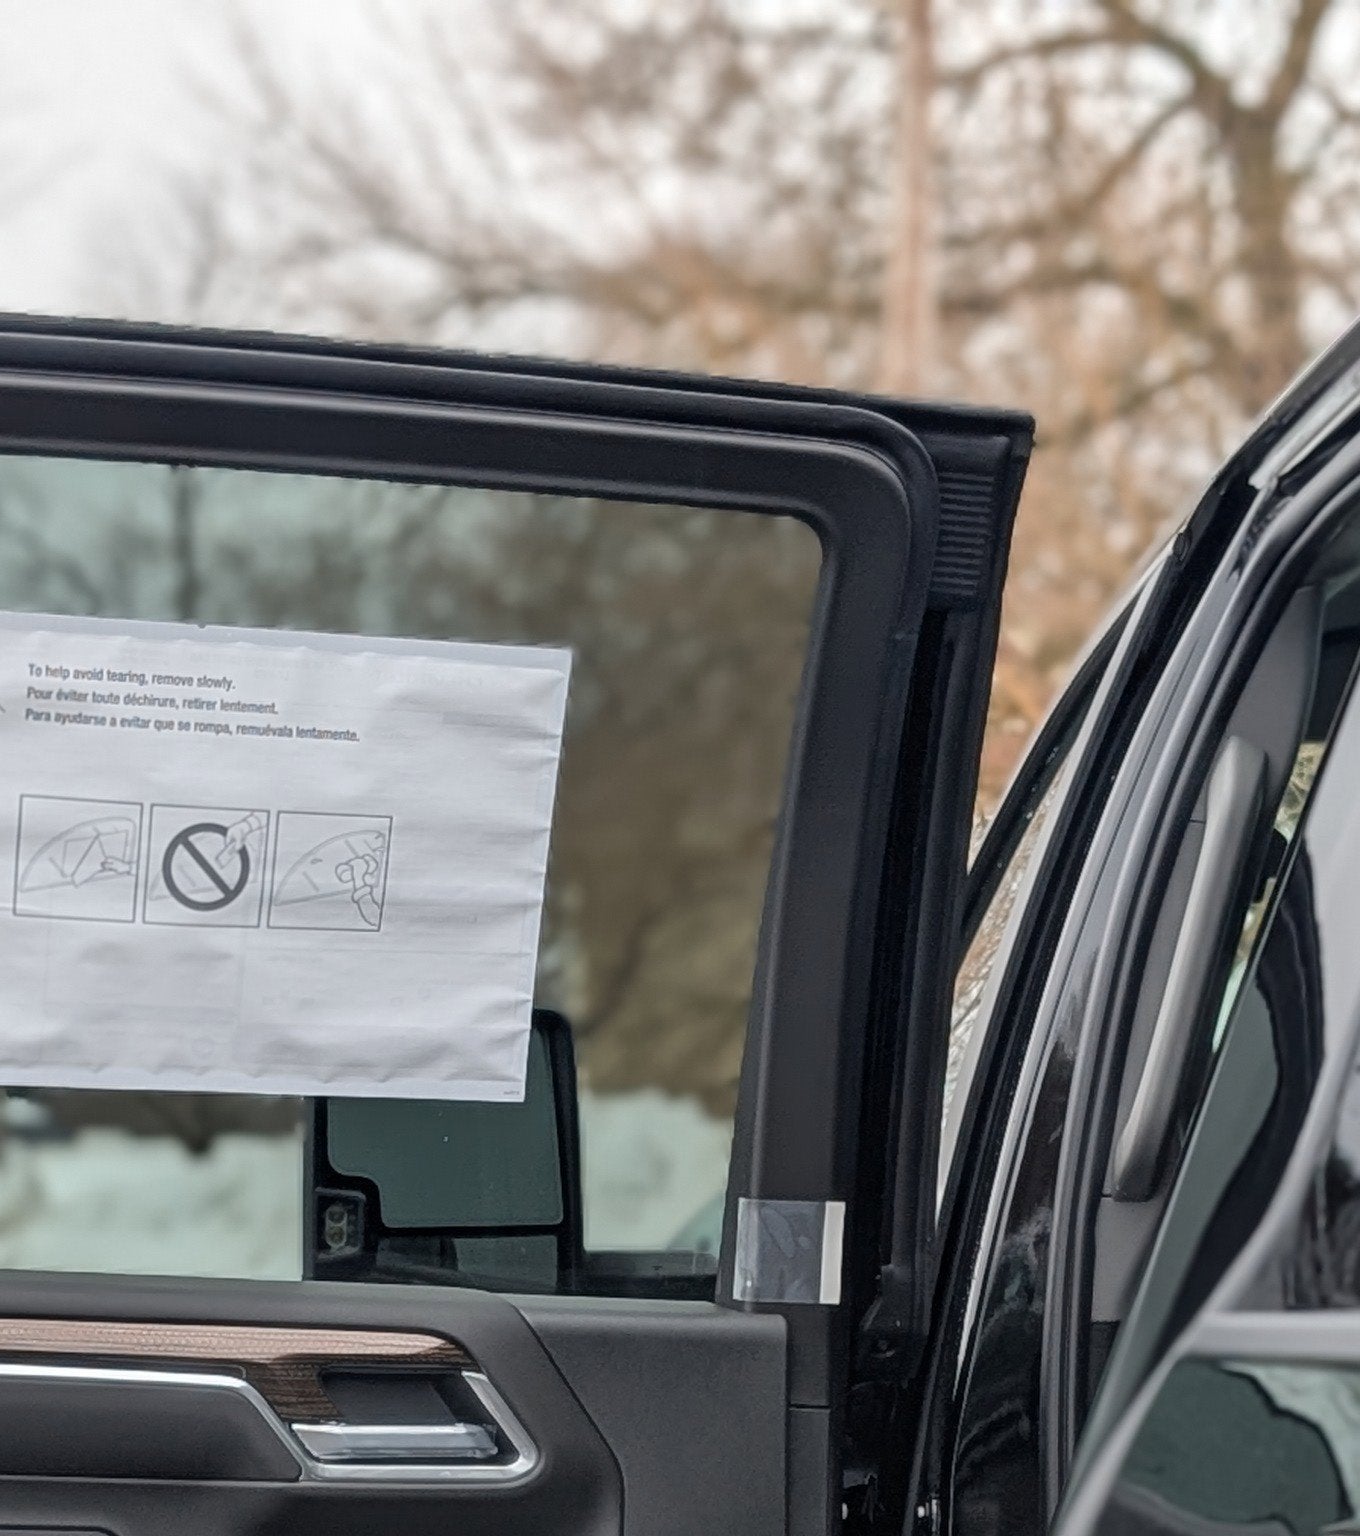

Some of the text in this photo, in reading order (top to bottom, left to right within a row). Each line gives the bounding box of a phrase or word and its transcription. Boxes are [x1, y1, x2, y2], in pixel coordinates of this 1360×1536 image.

[29, 663, 236, 692] To help avoid tearing, remove slowly.
[27, 686, 279, 715] Pour éviter toute déchirure, retirer lentement.
[25, 708, 51, 721] Para
[54, 711, 107, 725] ayudarse
[110, 717, 117, 727] a
[120, 716, 151, 729] evitar
[154, 720, 175, 731] que
[178, 720, 191, 731] se
[194, 721, 233, 736] rompa,
[296, 726, 360, 742] lentamente.
